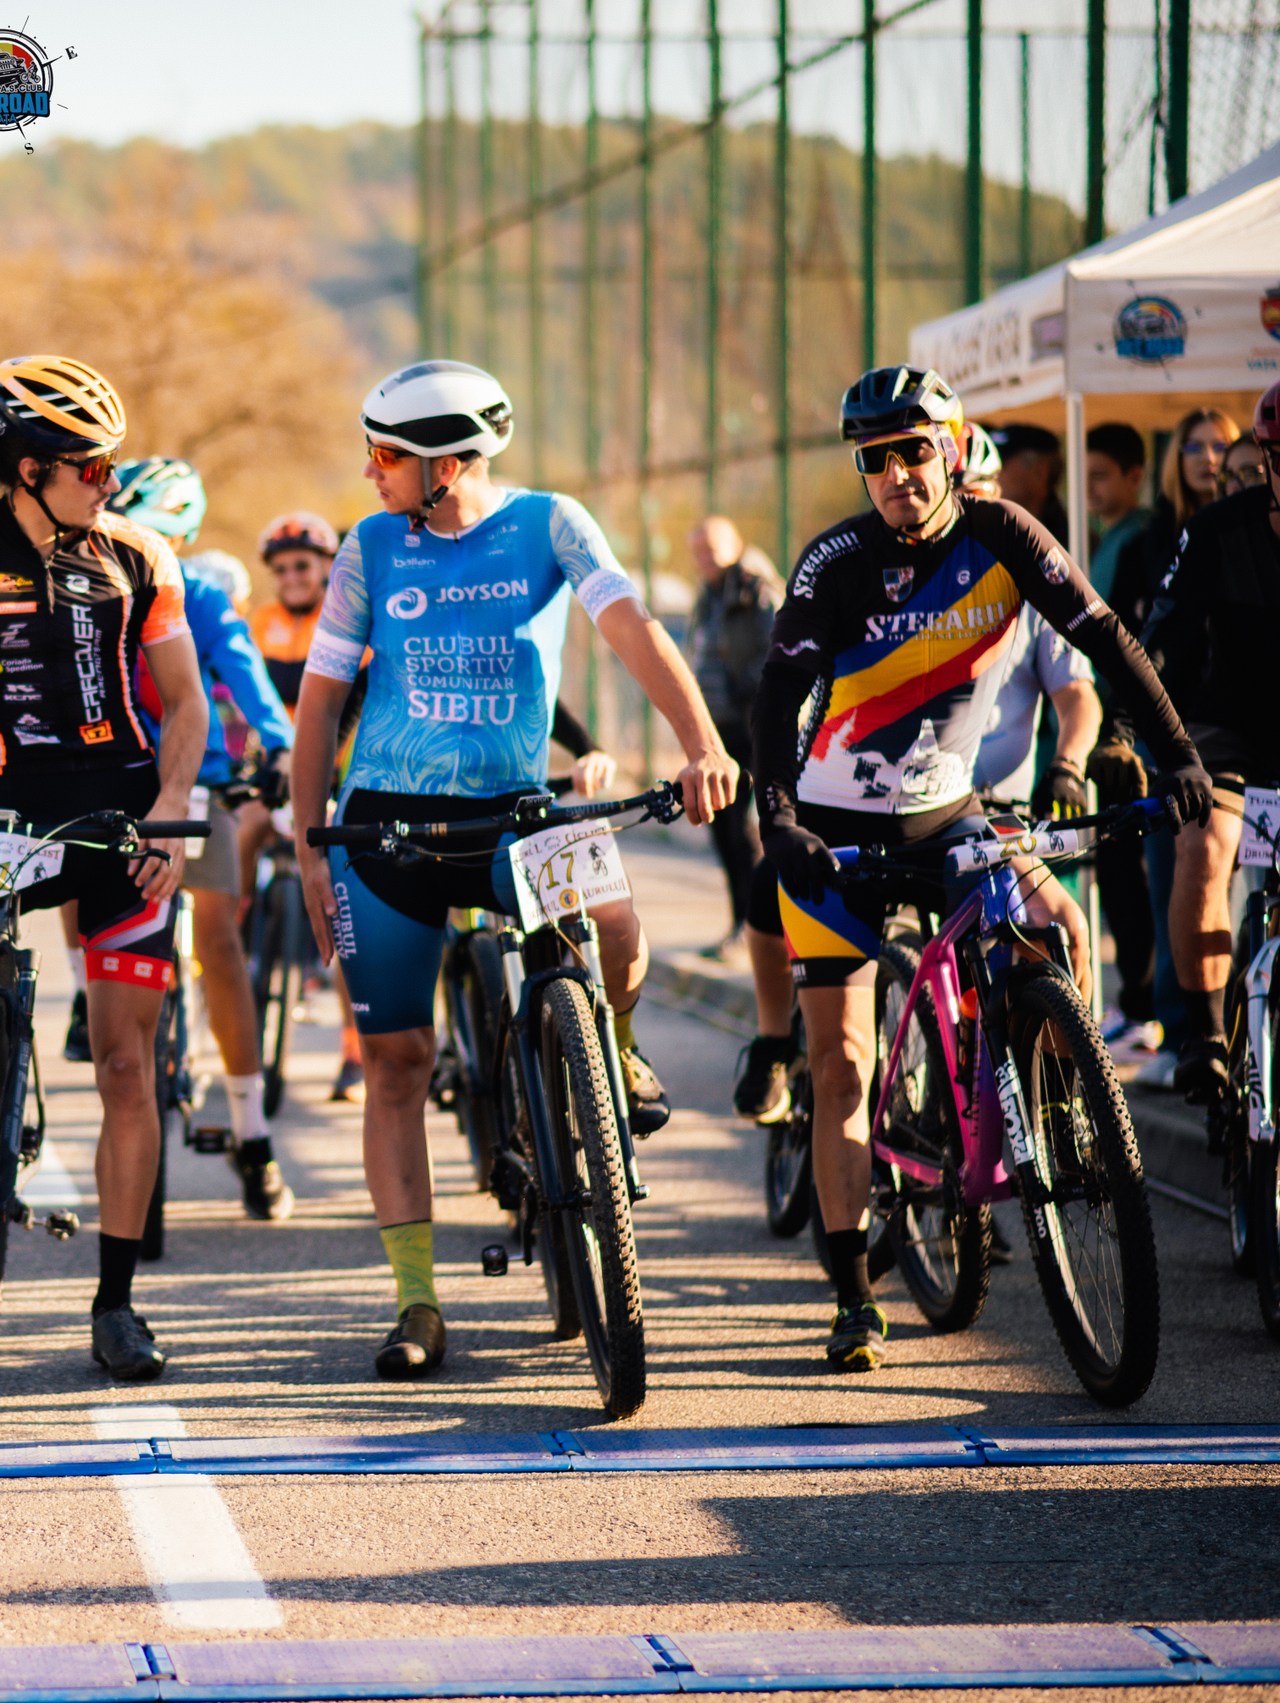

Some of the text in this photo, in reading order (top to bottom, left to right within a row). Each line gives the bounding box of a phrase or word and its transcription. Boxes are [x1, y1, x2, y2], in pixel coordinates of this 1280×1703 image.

[436, 578, 529, 603] JOYSON
[865, 601, 1005, 643] STEGARII
[404, 635, 515, 655] CLUBUL
[405, 656, 515, 675] SPORTIV
[407, 674, 514, 690] COMUNITAR
[407, 689, 518, 726] SIBIU
[545, 851, 574, 890] 17
[334, 882, 358, 960] CLUBUL
